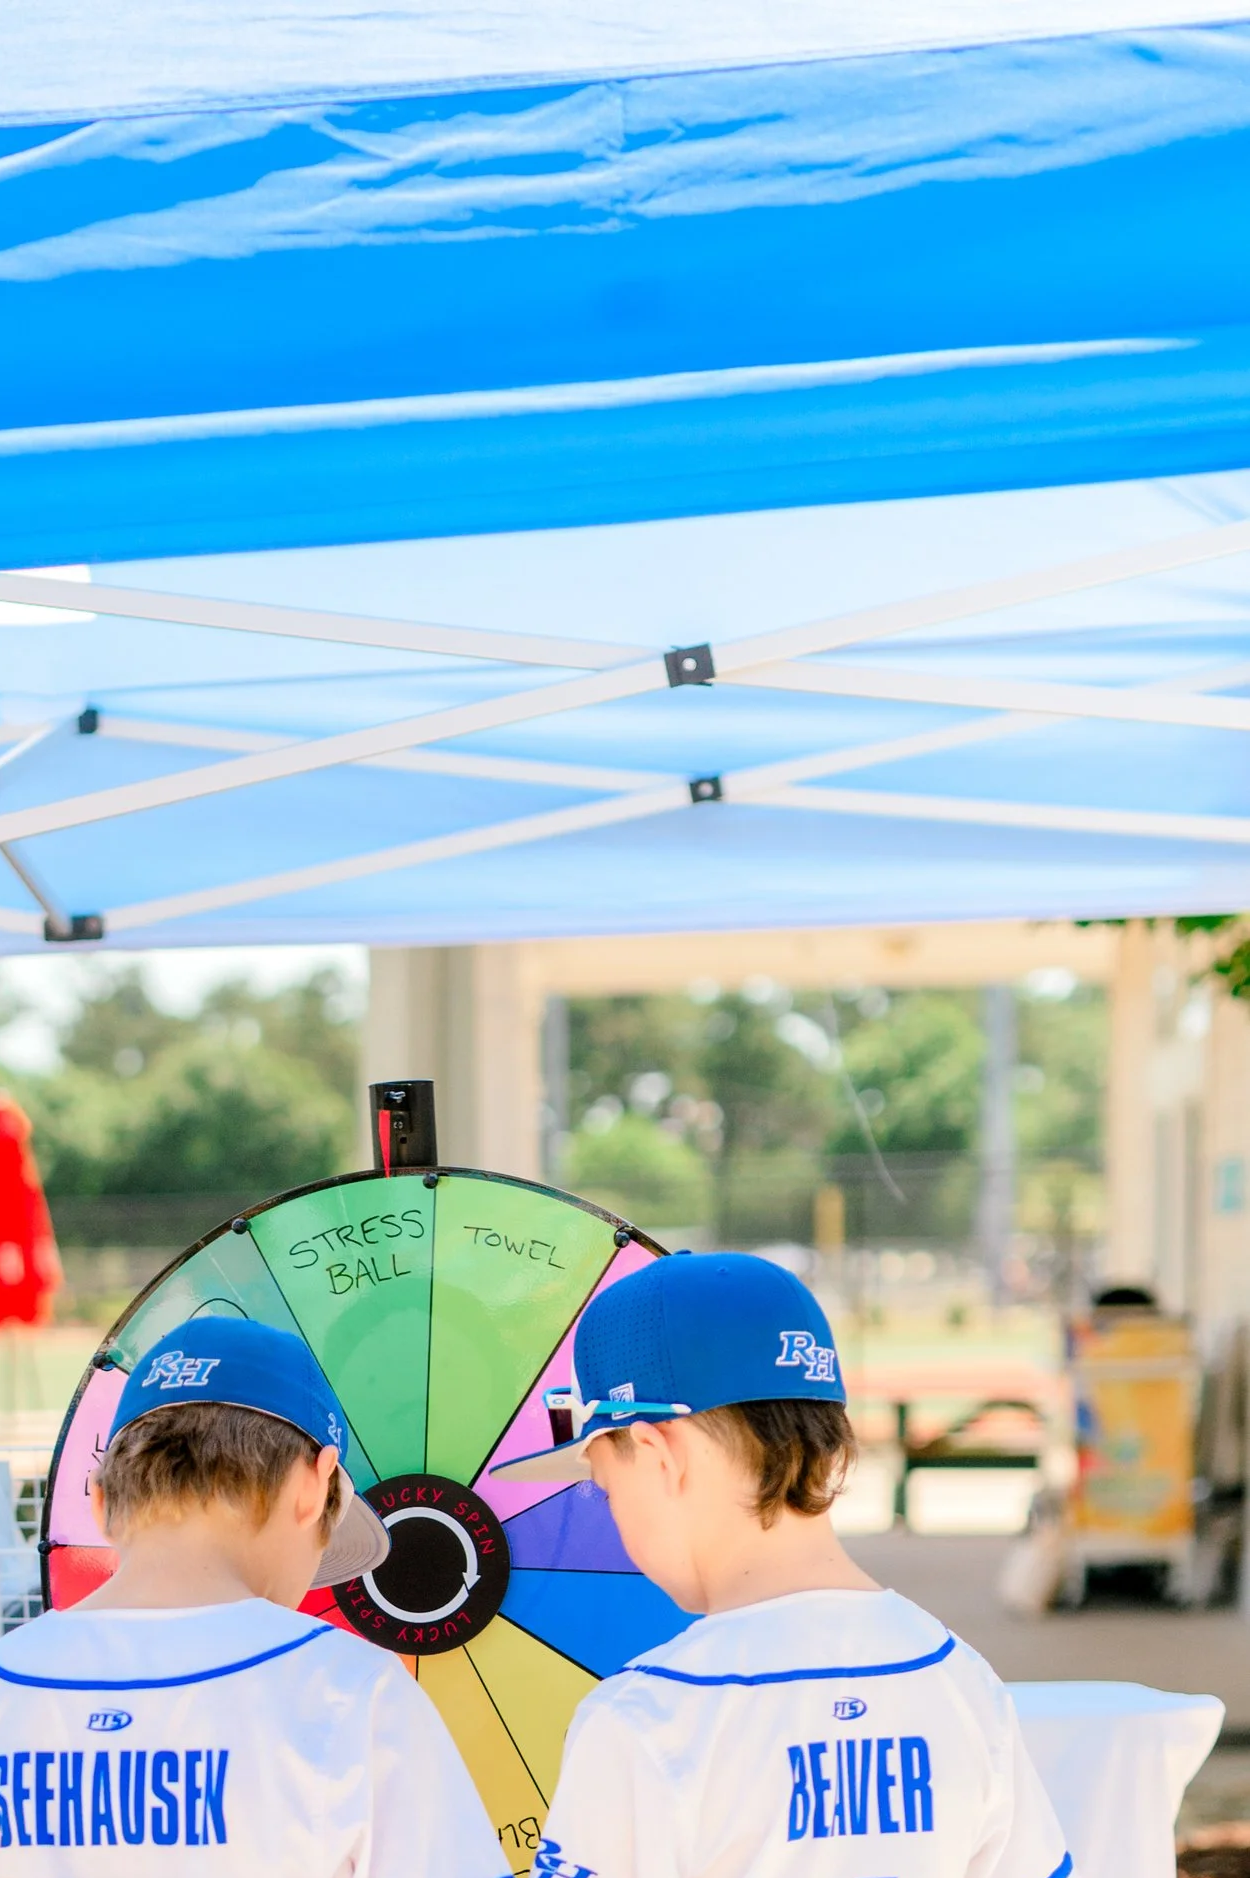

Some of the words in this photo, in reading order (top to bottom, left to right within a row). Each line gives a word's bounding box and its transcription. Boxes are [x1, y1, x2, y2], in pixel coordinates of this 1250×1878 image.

[289, 1209, 425, 1269] STRESS
[463, 1225, 566, 1270] TOWEL
[325, 1254, 412, 1295] BALL
[141, 1350, 220, 1390] RH
[775, 1331, 836, 1382] RH
[453, 1501, 496, 1556] SPIN
[396, 1610, 472, 1644] LUCKY
[786, 1735, 934, 1842] BEAVER
